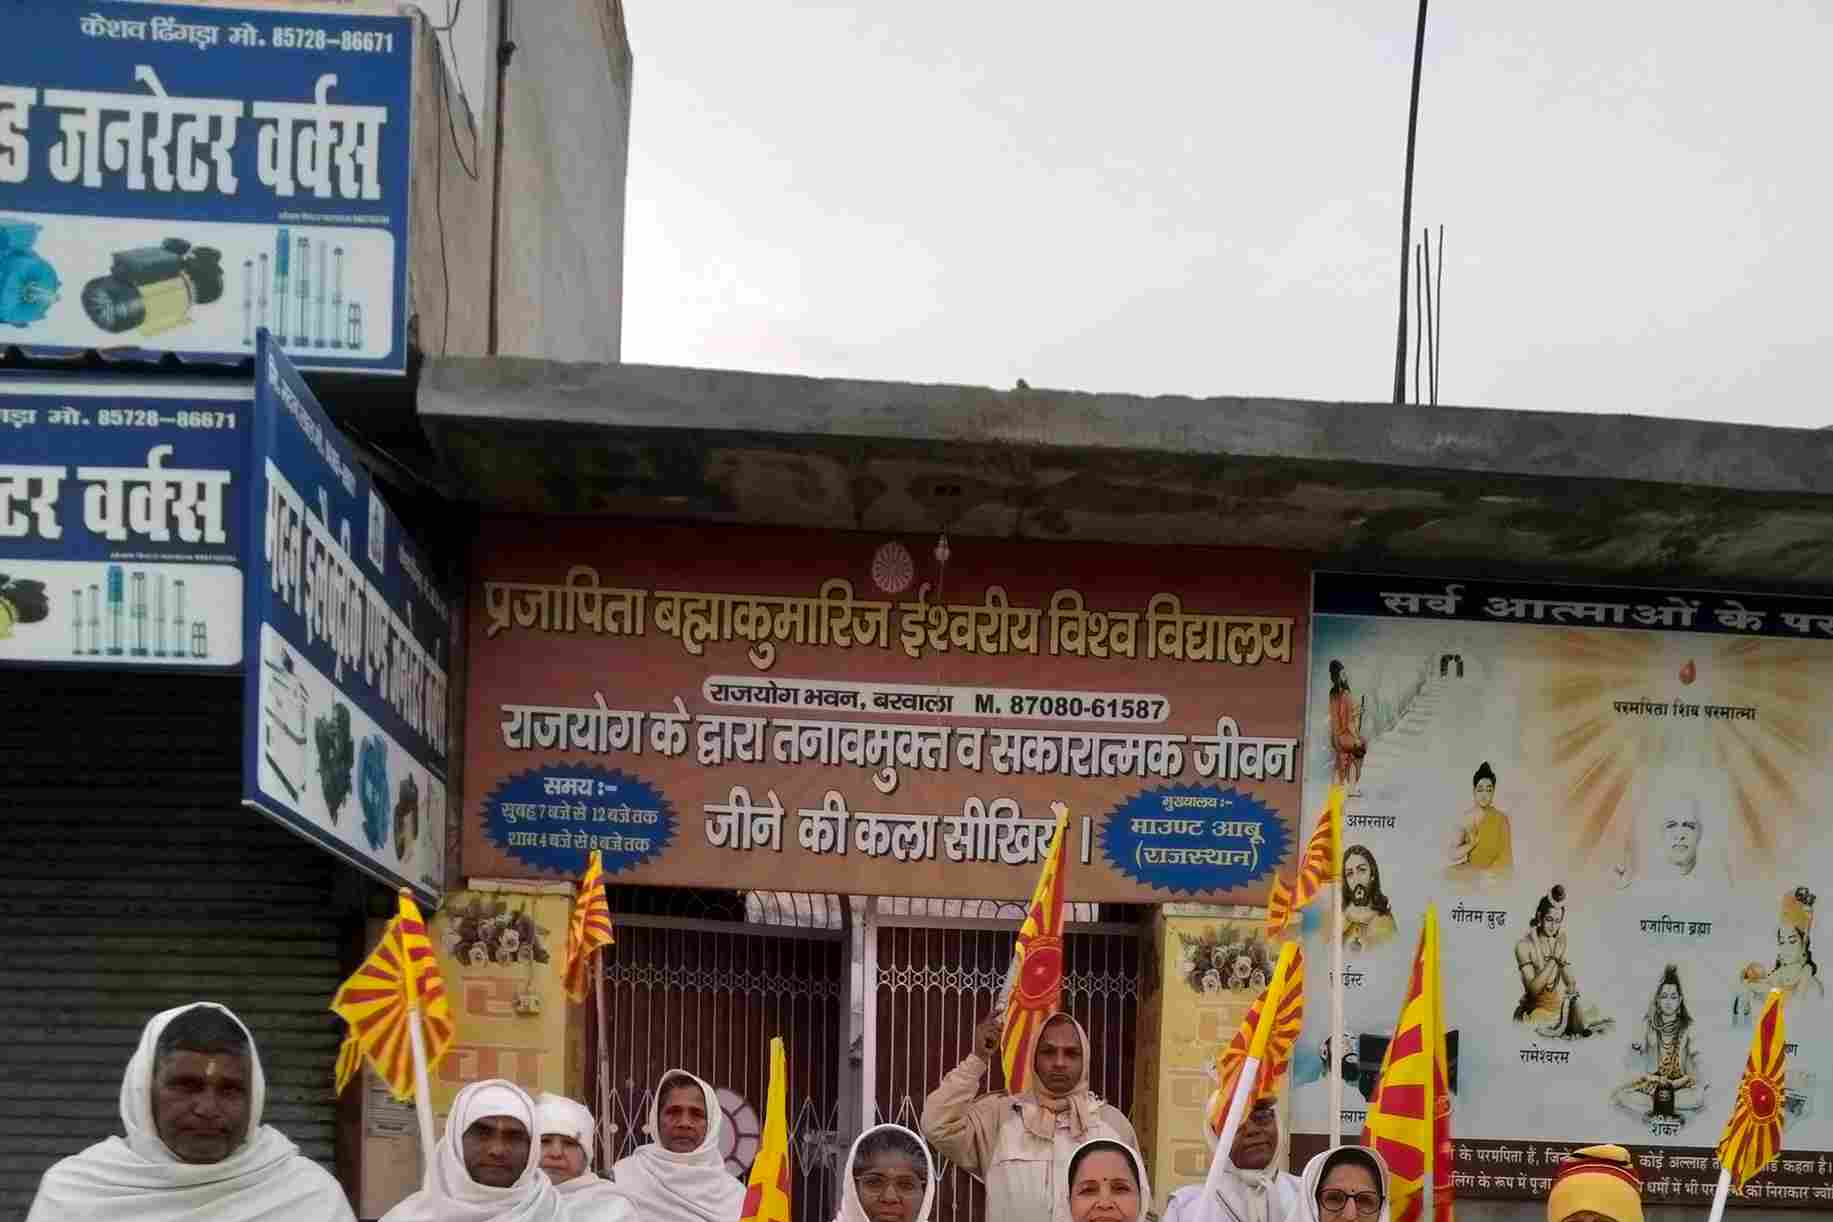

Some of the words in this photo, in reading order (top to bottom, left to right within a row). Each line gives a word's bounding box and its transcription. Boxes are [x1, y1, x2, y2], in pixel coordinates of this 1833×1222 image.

[43, 65, 244, 194] जनरेटर
[484, 564, 649, 638] प्रजापिता
[897, 582, 1041, 658] ईश्वरीय
[1048, 589, 1140, 658] विश्व
[1145, 592, 1295, 664] विद्यालय
[1380, 584, 1465, 615] सर्व
[1484, 596, 1702, 628] आत्माओं
[1713, 600, 1768, 632] के
[709, 680, 800, 705] राजयोग
[803, 689, 867, 709] भवन,
[873, 691, 954, 714] बरवाला
[975, 694, 1001, 714] M.
[1010, 695, 1165, 720] 87080-61587
[1613, 696, 1669, 716] परमपिता
[1673, 697, 1701, 718] शिव
[1703, 704, 1758, 721] परमात्मा
[500, 690, 645, 754] राजयोग
[648, 696, 691, 757] के
[696, 714, 768, 766] द्वारा
[772, 718, 952, 793] तनावमुक्त
[955, 728, 985, 771] व
[989, 728, 1189, 777] सकारात्मक
[1191, 716, 1299, 782] जीवन
[591, 806, 606, 822] 12
[631, 809, 660, 825] तक
[703, 785, 785, 852] जीने
[798, 790, 849, 855] की
[854, 812, 938, 861] कला
[1346, 814, 1397, 829] अमरनाथ
[624, 838, 651, 852] तक
[1131, 818, 1206, 837] माउण्ट
[1211, 820, 1266, 847] आबू
[1135, 840, 1260, 873] (राजस्थान)
[1452, 902, 1484, 923] गौतम
[1640, 914, 1686, 937] प्रजापिता
[1519, 1043, 1570, 1064] रामेश्वरम
[1459, 1144, 1474, 1162] के
[1477, 1146, 1523, 1163] परमपिता
[1669, 1156, 1708, 1170] अल्लाह
[1783, 1159, 1815, 1174] कहता
[1478, 1171, 1491, 1188] के
[1494, 1176, 1514, 1189] रूप
[1765, 1182, 1809, 1199] निराकार
